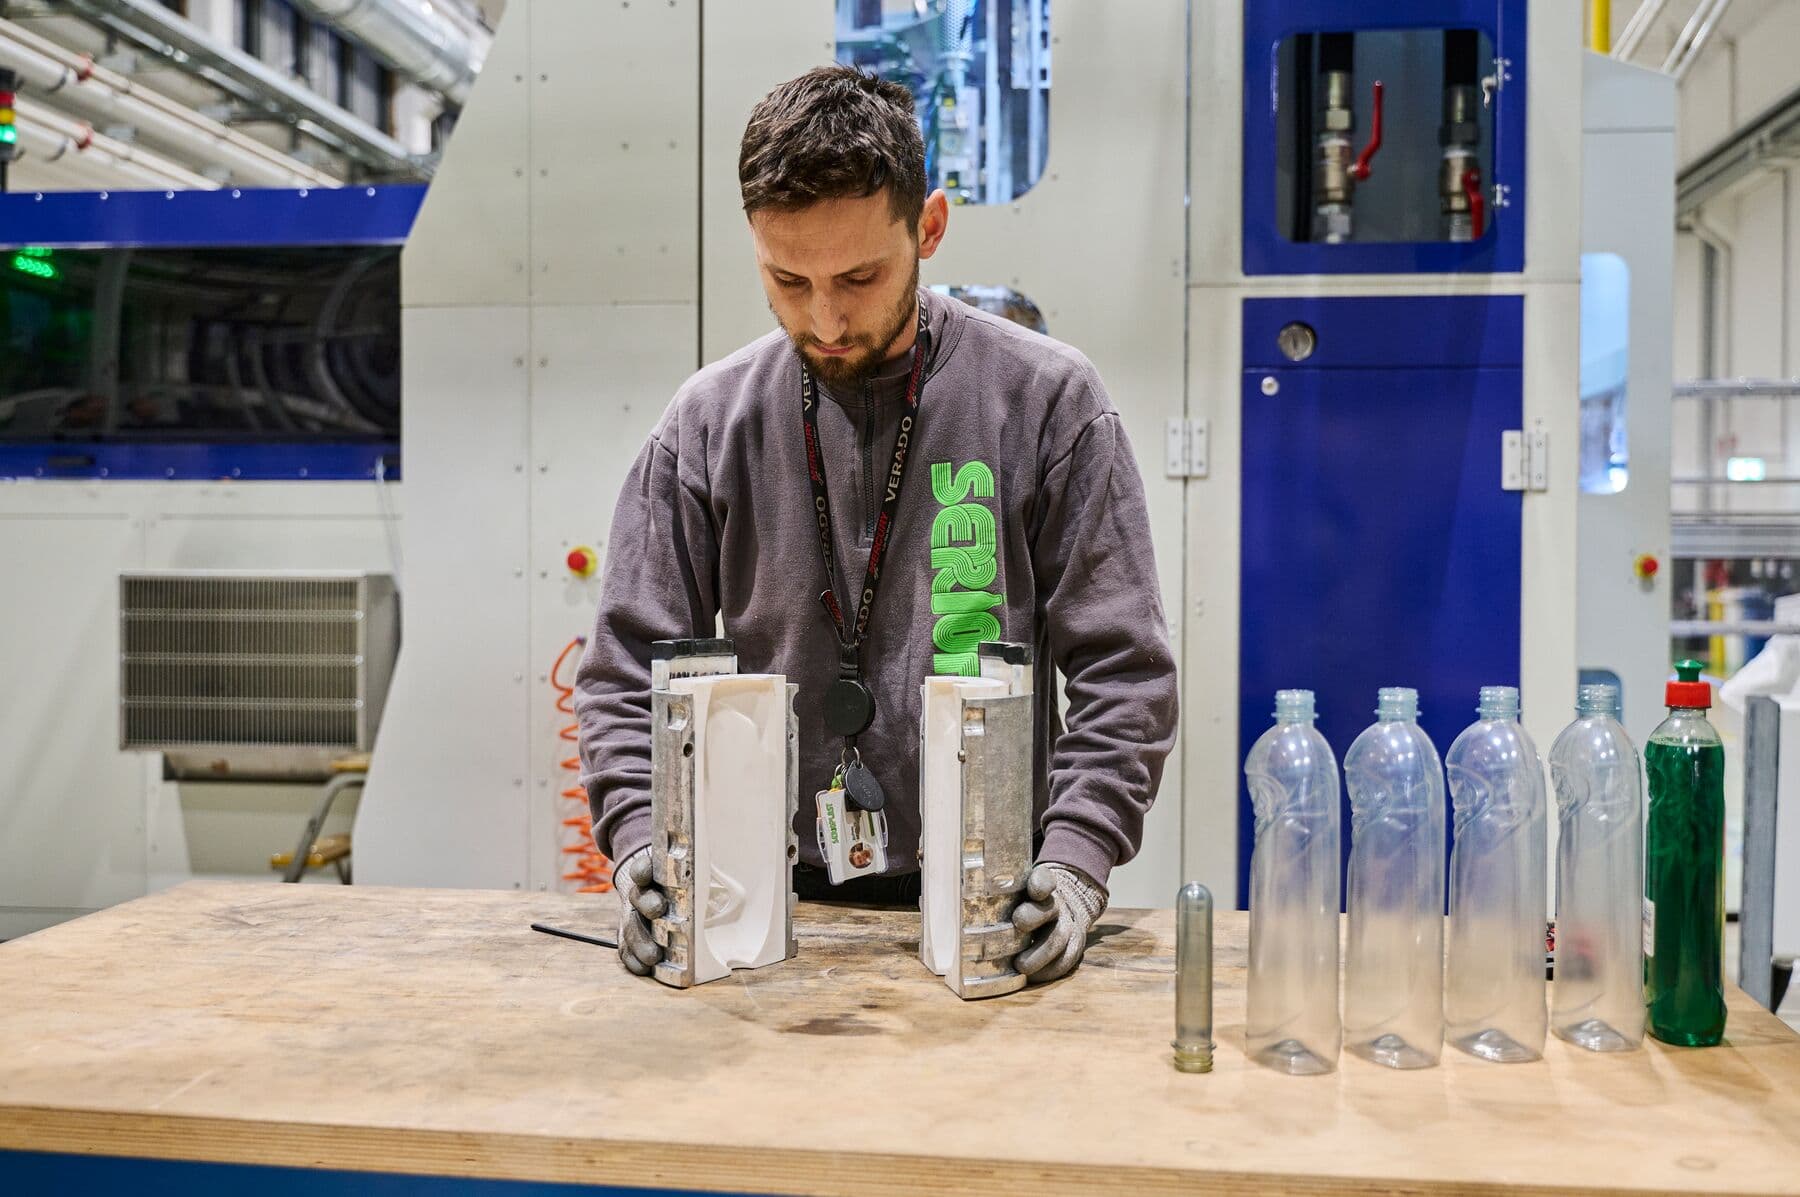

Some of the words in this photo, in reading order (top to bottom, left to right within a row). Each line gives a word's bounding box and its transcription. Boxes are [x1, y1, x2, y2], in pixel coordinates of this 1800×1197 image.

[804, 420, 819, 481] MERCURY
[884, 416, 912, 502] VERADO
[868, 511, 888, 576] MERCURY
